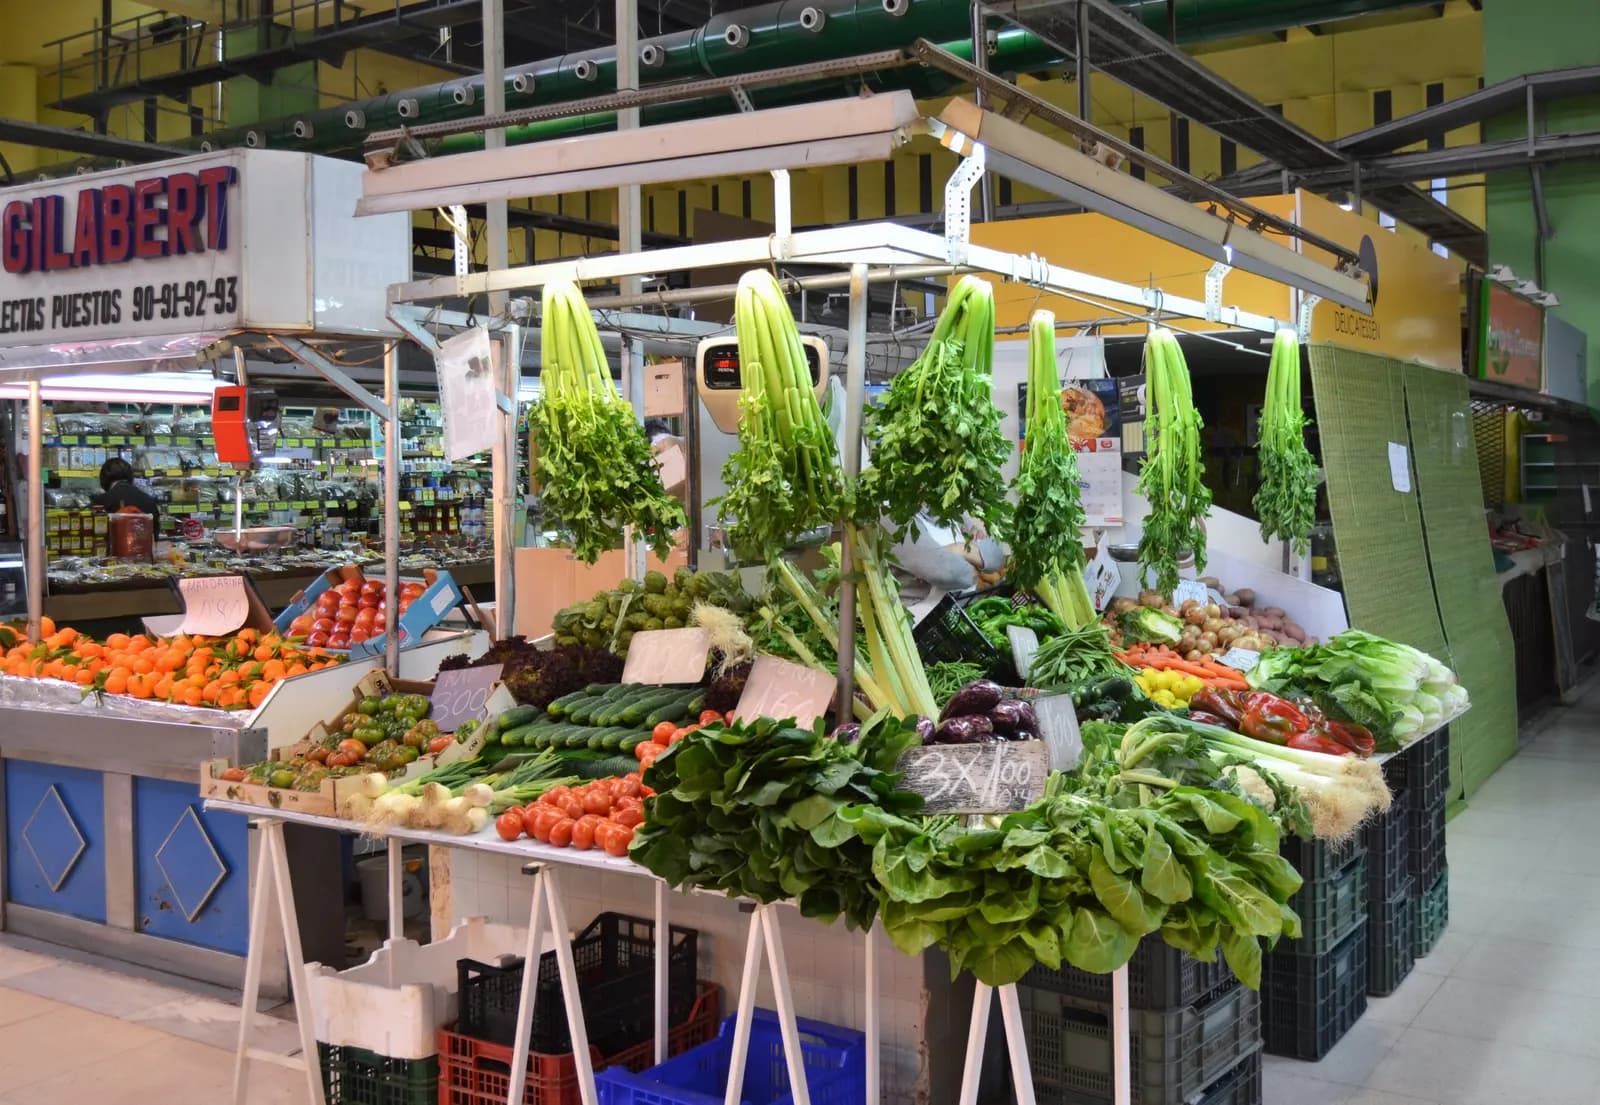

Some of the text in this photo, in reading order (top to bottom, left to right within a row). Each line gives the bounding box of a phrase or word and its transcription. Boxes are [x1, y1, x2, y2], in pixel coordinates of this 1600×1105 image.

[3, 165, 237, 274] GILABERT
[0, 276, 238, 333] ECTAS PUESTOS 90-91-92-93
[1334, 311, 1381, 340] DELICATESSEN
